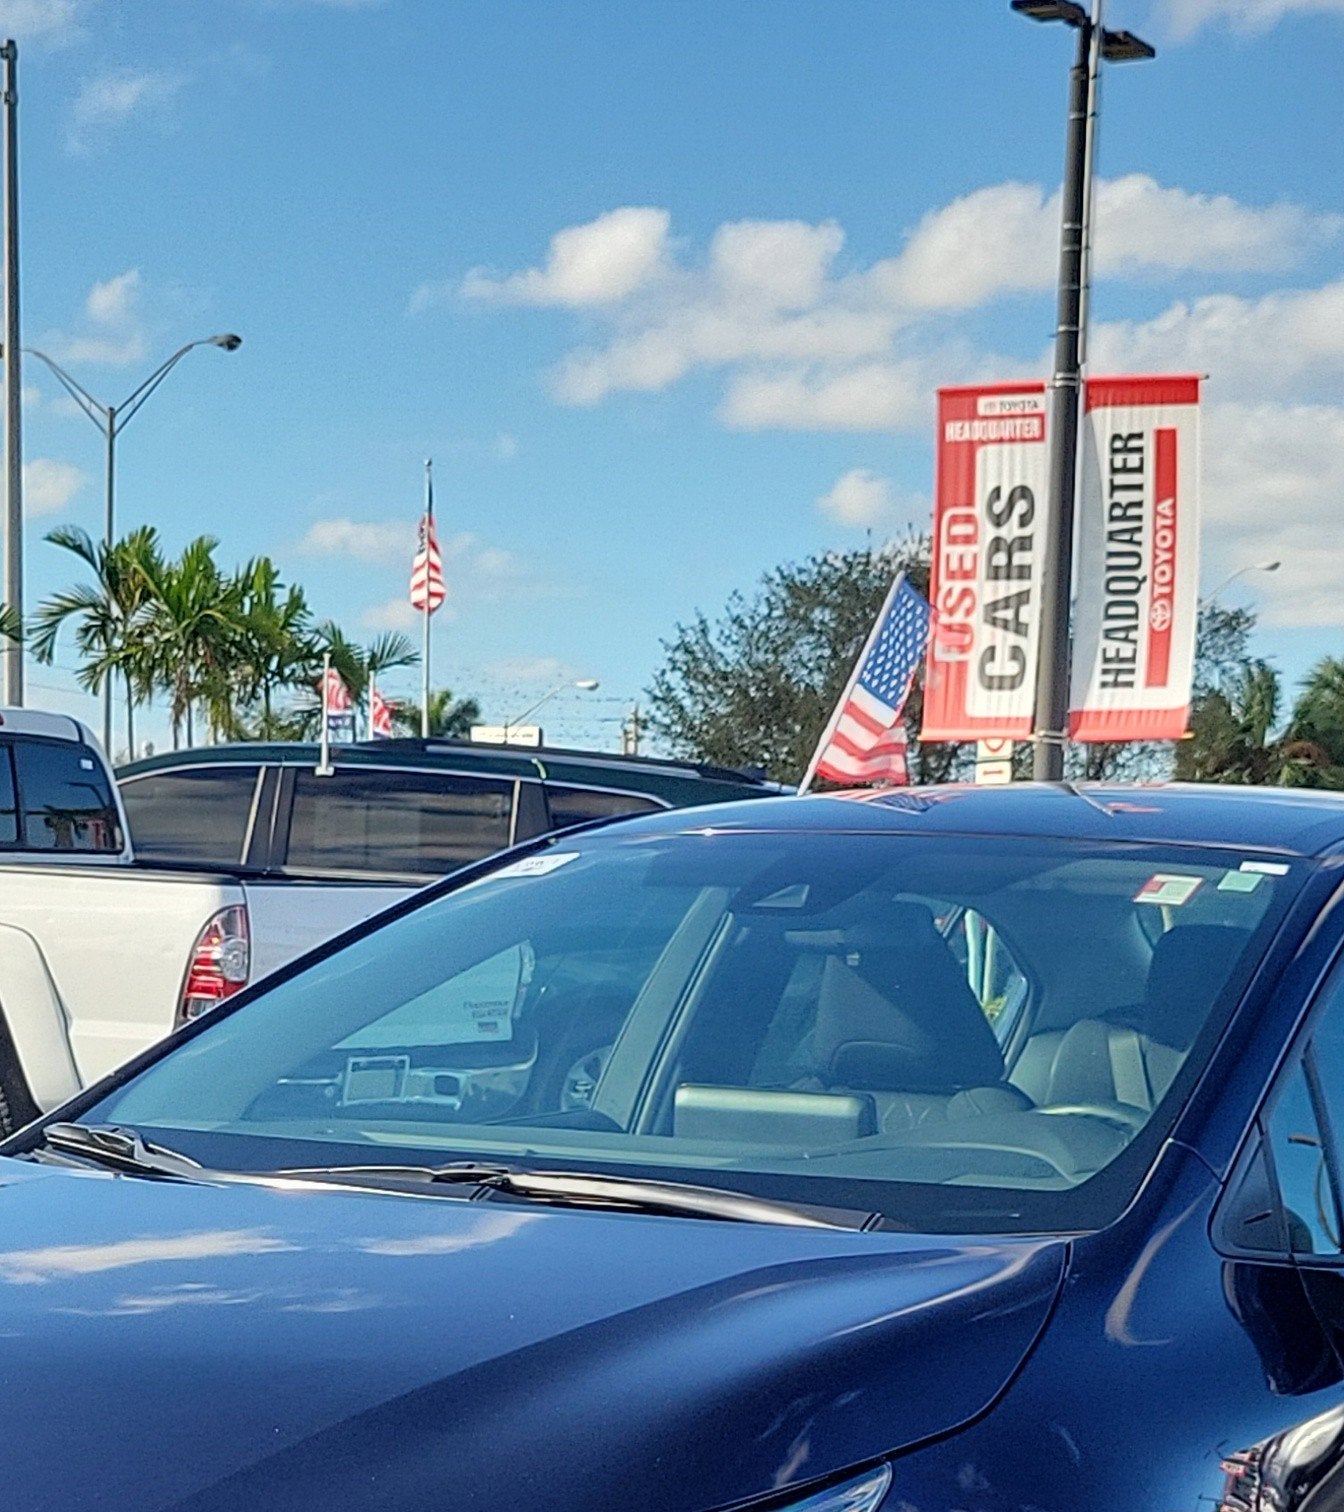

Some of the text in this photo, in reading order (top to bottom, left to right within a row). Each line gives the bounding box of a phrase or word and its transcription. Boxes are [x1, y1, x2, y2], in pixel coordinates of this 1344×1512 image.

[936, 512, 979, 654] USED
[978, 484, 1036, 692] CARS
[1100, 430, 1147, 690] HEADQUARTER
[1154, 498, 1175, 601] TOYOTA
